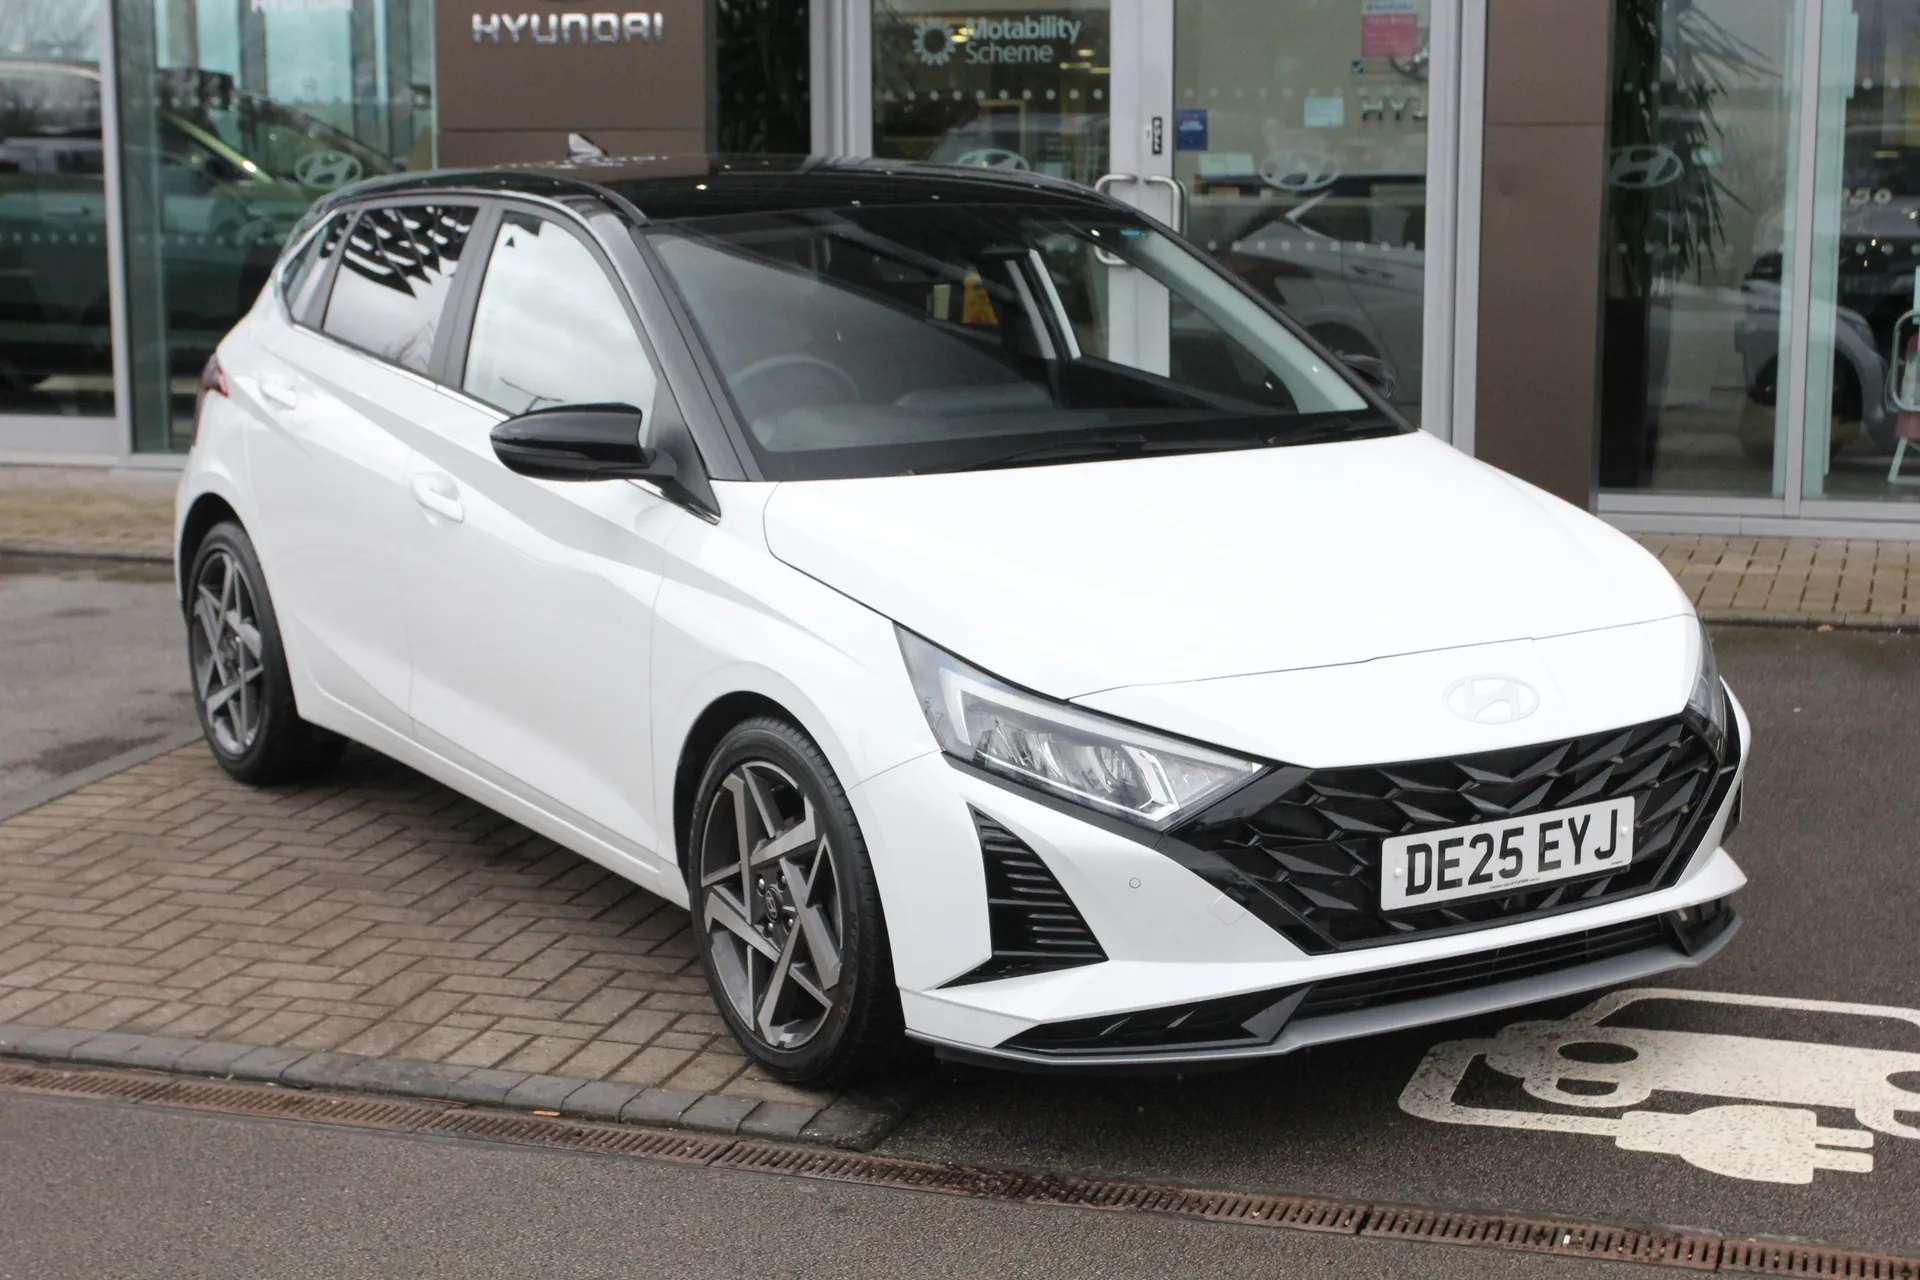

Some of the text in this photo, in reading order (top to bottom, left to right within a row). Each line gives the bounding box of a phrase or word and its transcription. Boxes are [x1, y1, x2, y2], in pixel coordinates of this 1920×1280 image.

[472, 12, 664, 44] HYUNDAI
[966, 15, 1081, 44] Motability
[965, 42, 1054, 64] Scheme
[1405, 808, 1618, 897] DE25 EYJ
